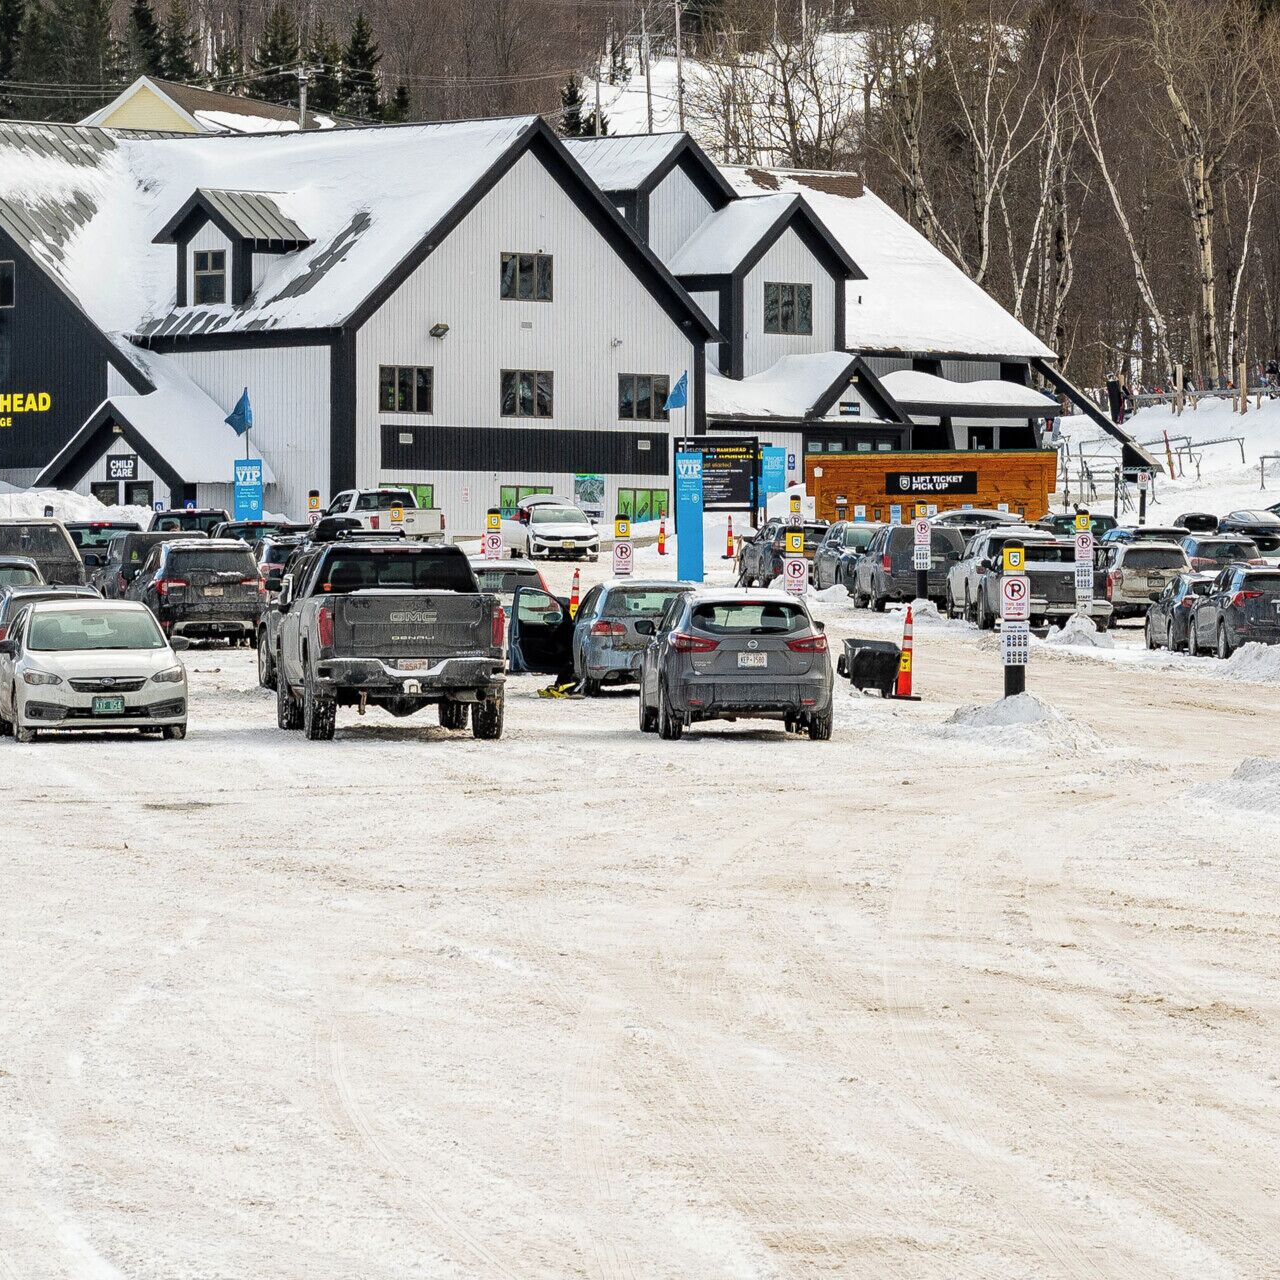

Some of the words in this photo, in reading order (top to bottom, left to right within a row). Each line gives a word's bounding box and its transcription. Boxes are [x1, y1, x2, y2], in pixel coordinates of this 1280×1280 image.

[110, 460, 134, 469] CHILD
[678, 465, 702, 474] VIP
[111, 469, 133, 477] CARE
[236, 470, 260, 481] VIP
[1011, 583, 1021, 597] P
[390, 611, 437, 622] GMC
